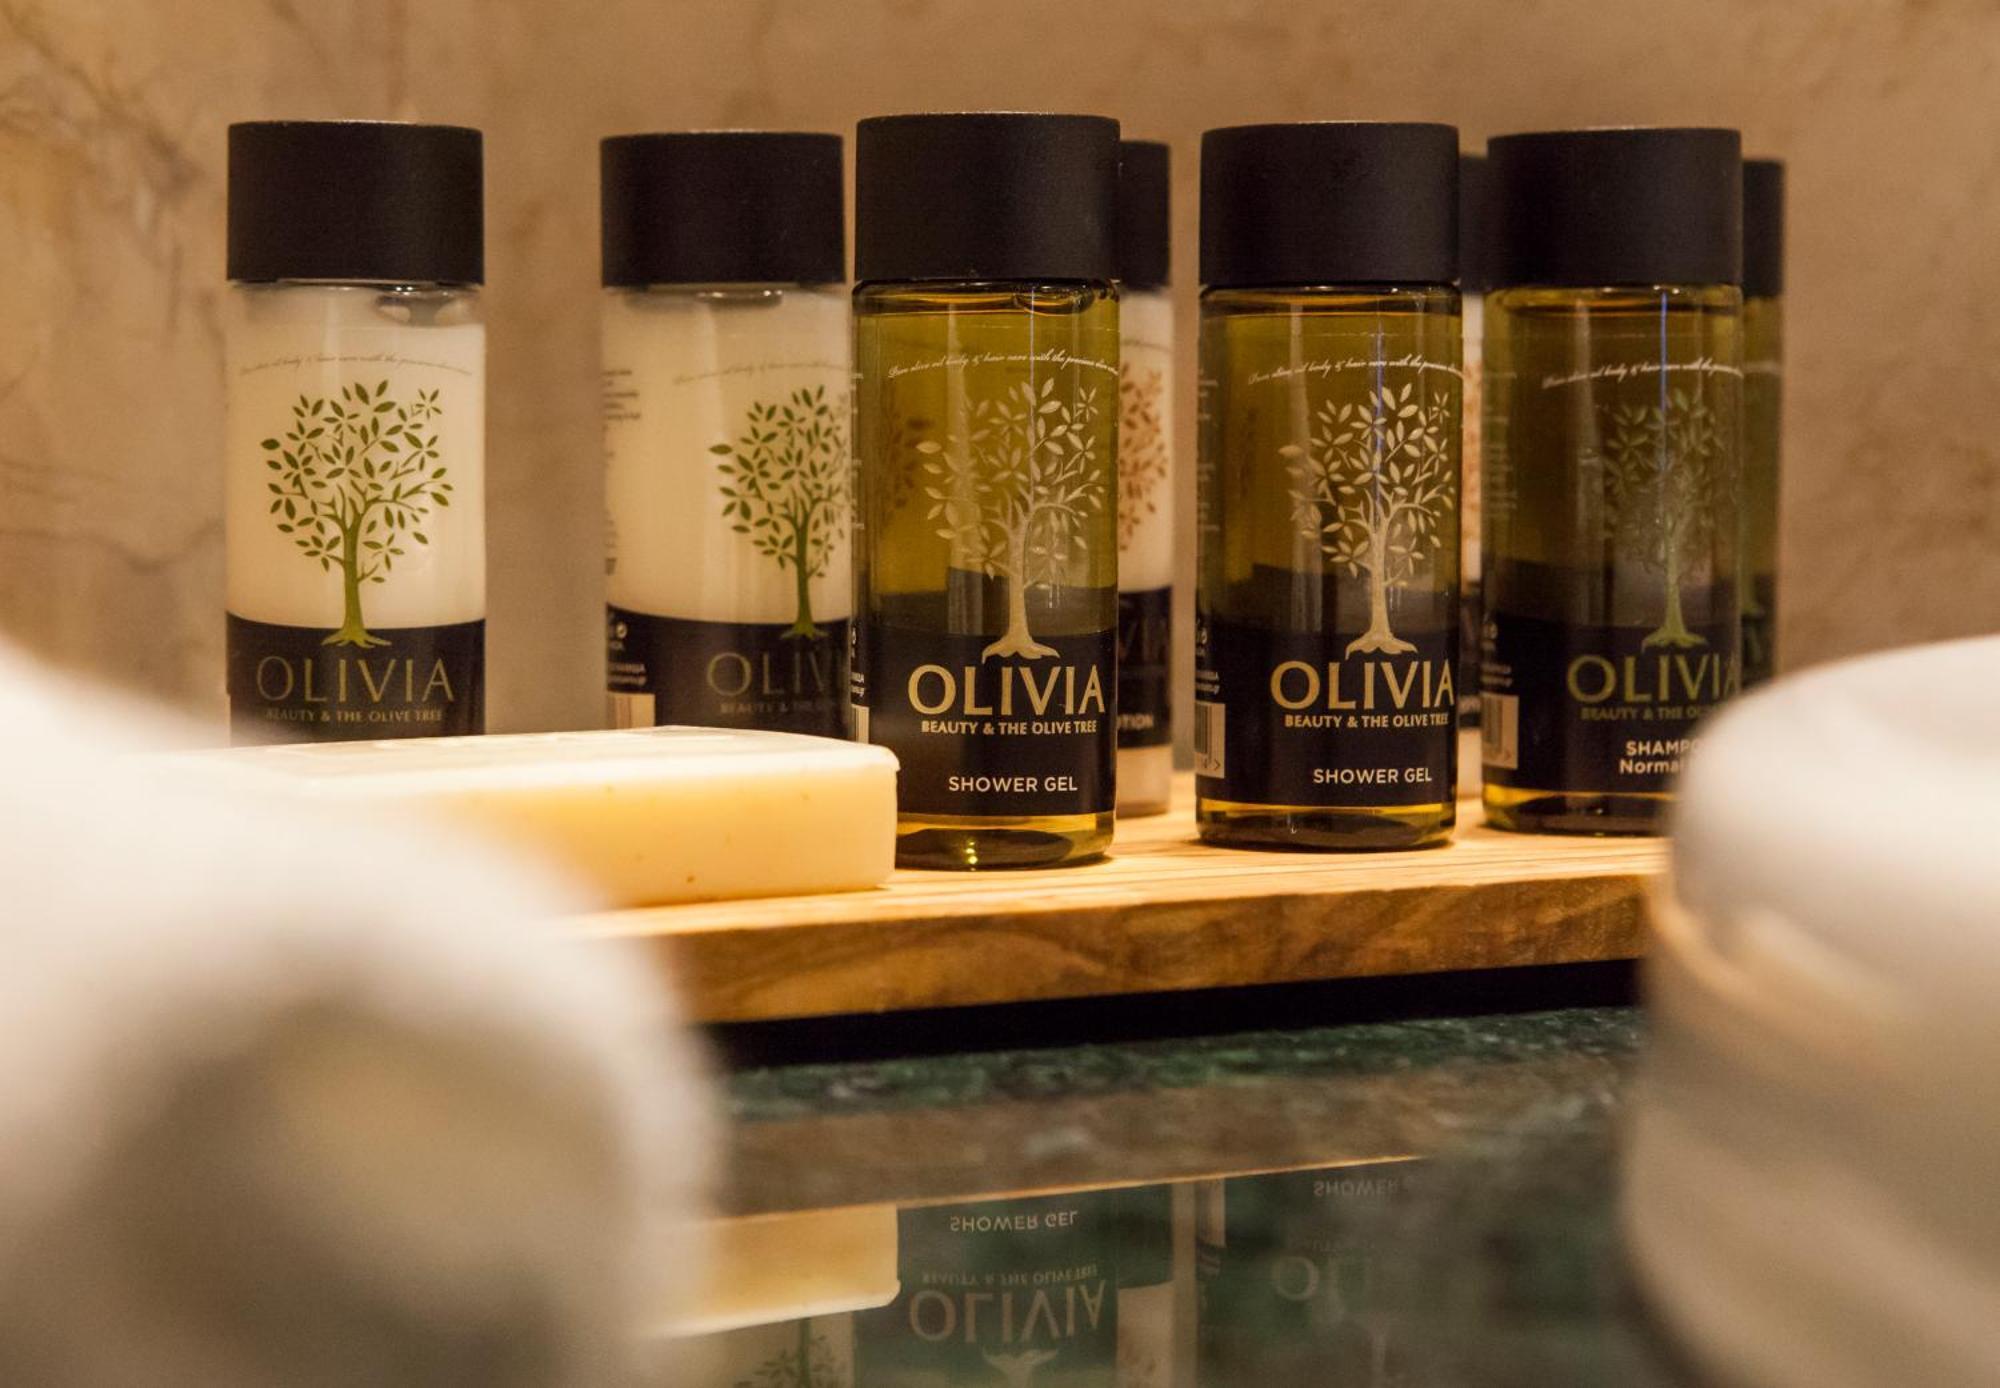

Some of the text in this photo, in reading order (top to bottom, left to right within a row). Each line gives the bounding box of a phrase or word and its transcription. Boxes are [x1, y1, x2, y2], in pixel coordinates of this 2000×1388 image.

[257, 655, 454, 703] OLIVIA
[1270, 659, 1455, 710] OLIVIA
[1567, 653, 1741, 704] OLIVIA
[908, 664, 1105, 716] OLIVIA
[265, 708, 443, 722] BEAUTY & THE OLIVE TREE
[1285, 712, 1449, 728] BEAUTY & THE OLIVE TREE
[1581, 707, 1637, 720] BEAUTY
[1658, 706, 1684, 720] THE
[921, 720, 1097, 735] BEAUTY & THE OLIVE TREE
[948, 776, 1078, 792] SHOWER GEL
[1313, 768, 1432, 784] SHOWER GEL
